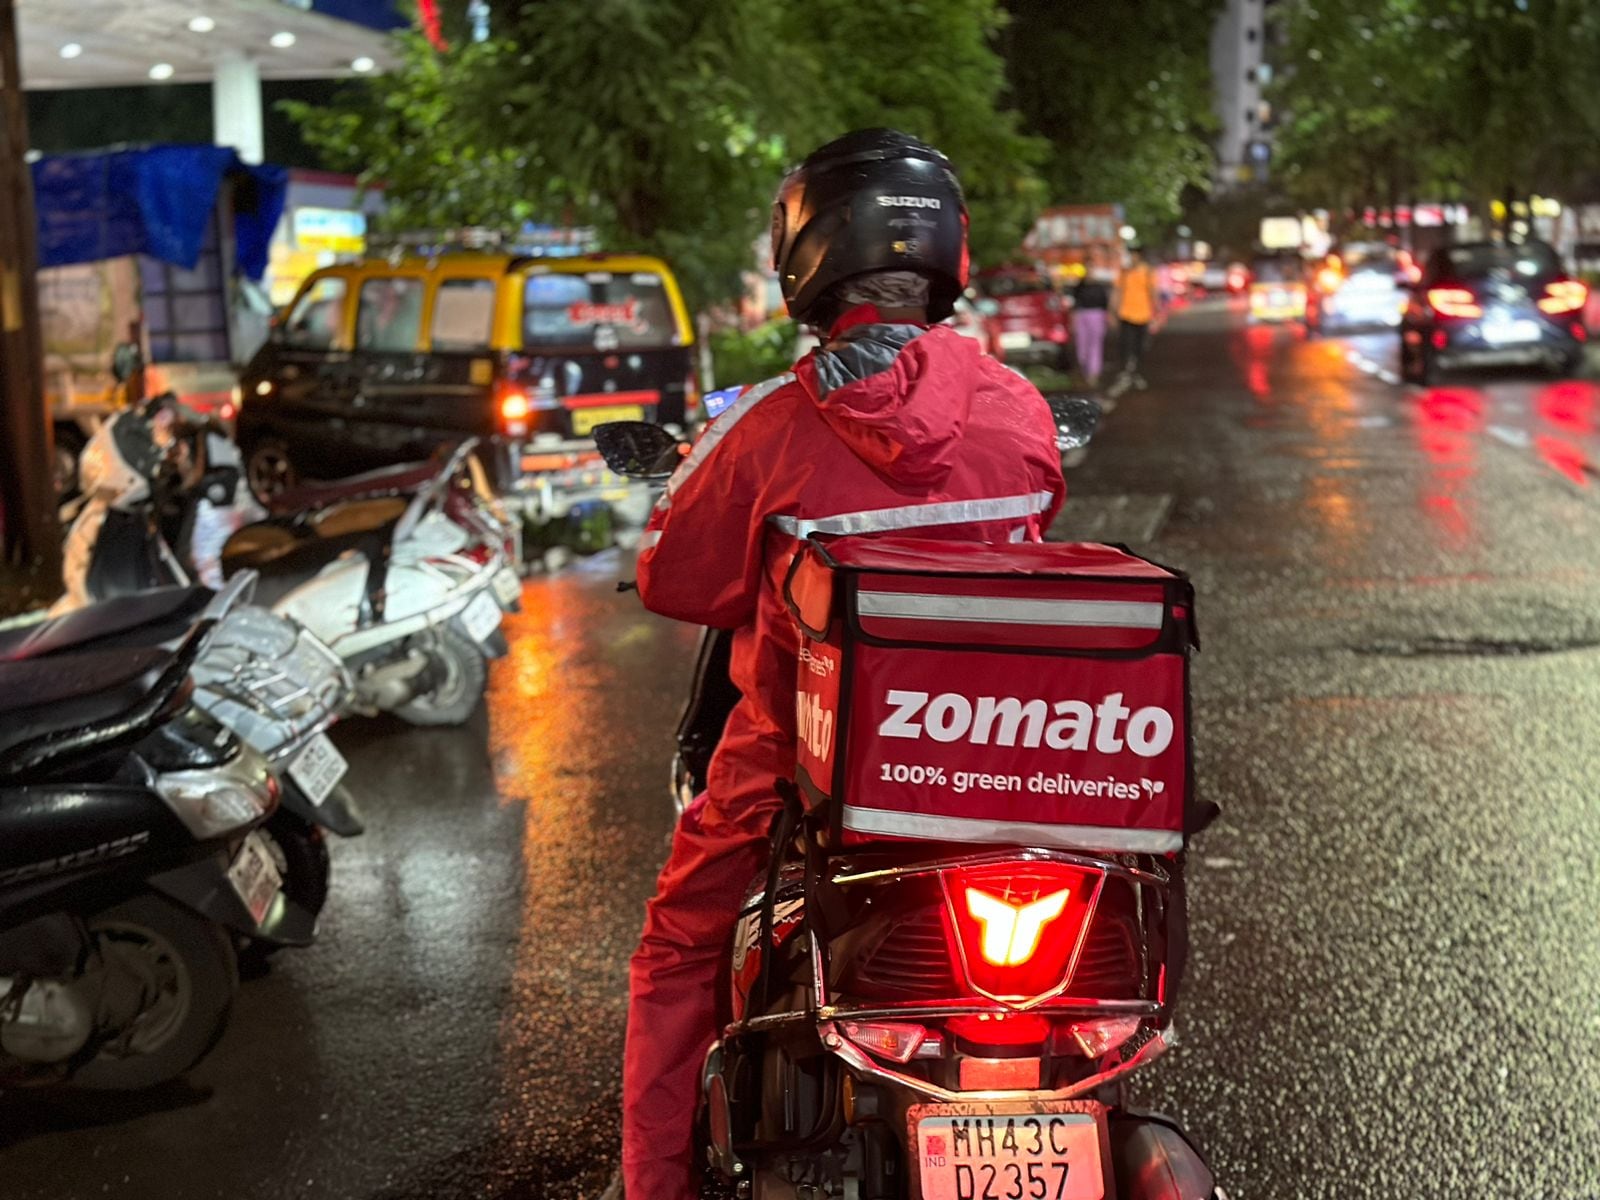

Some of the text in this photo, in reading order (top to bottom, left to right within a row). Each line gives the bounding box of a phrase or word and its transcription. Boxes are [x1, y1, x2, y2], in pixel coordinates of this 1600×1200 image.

[876, 196, 941, 210] SUZUKI
[878, 689, 1174, 758] zomato
[880, 762, 1141, 800] 100% green deliveries
[951, 1117, 1069, 1158] MH43C
[925, 1156, 947, 1169] IND
[955, 1162, 1070, 1200] D2357
